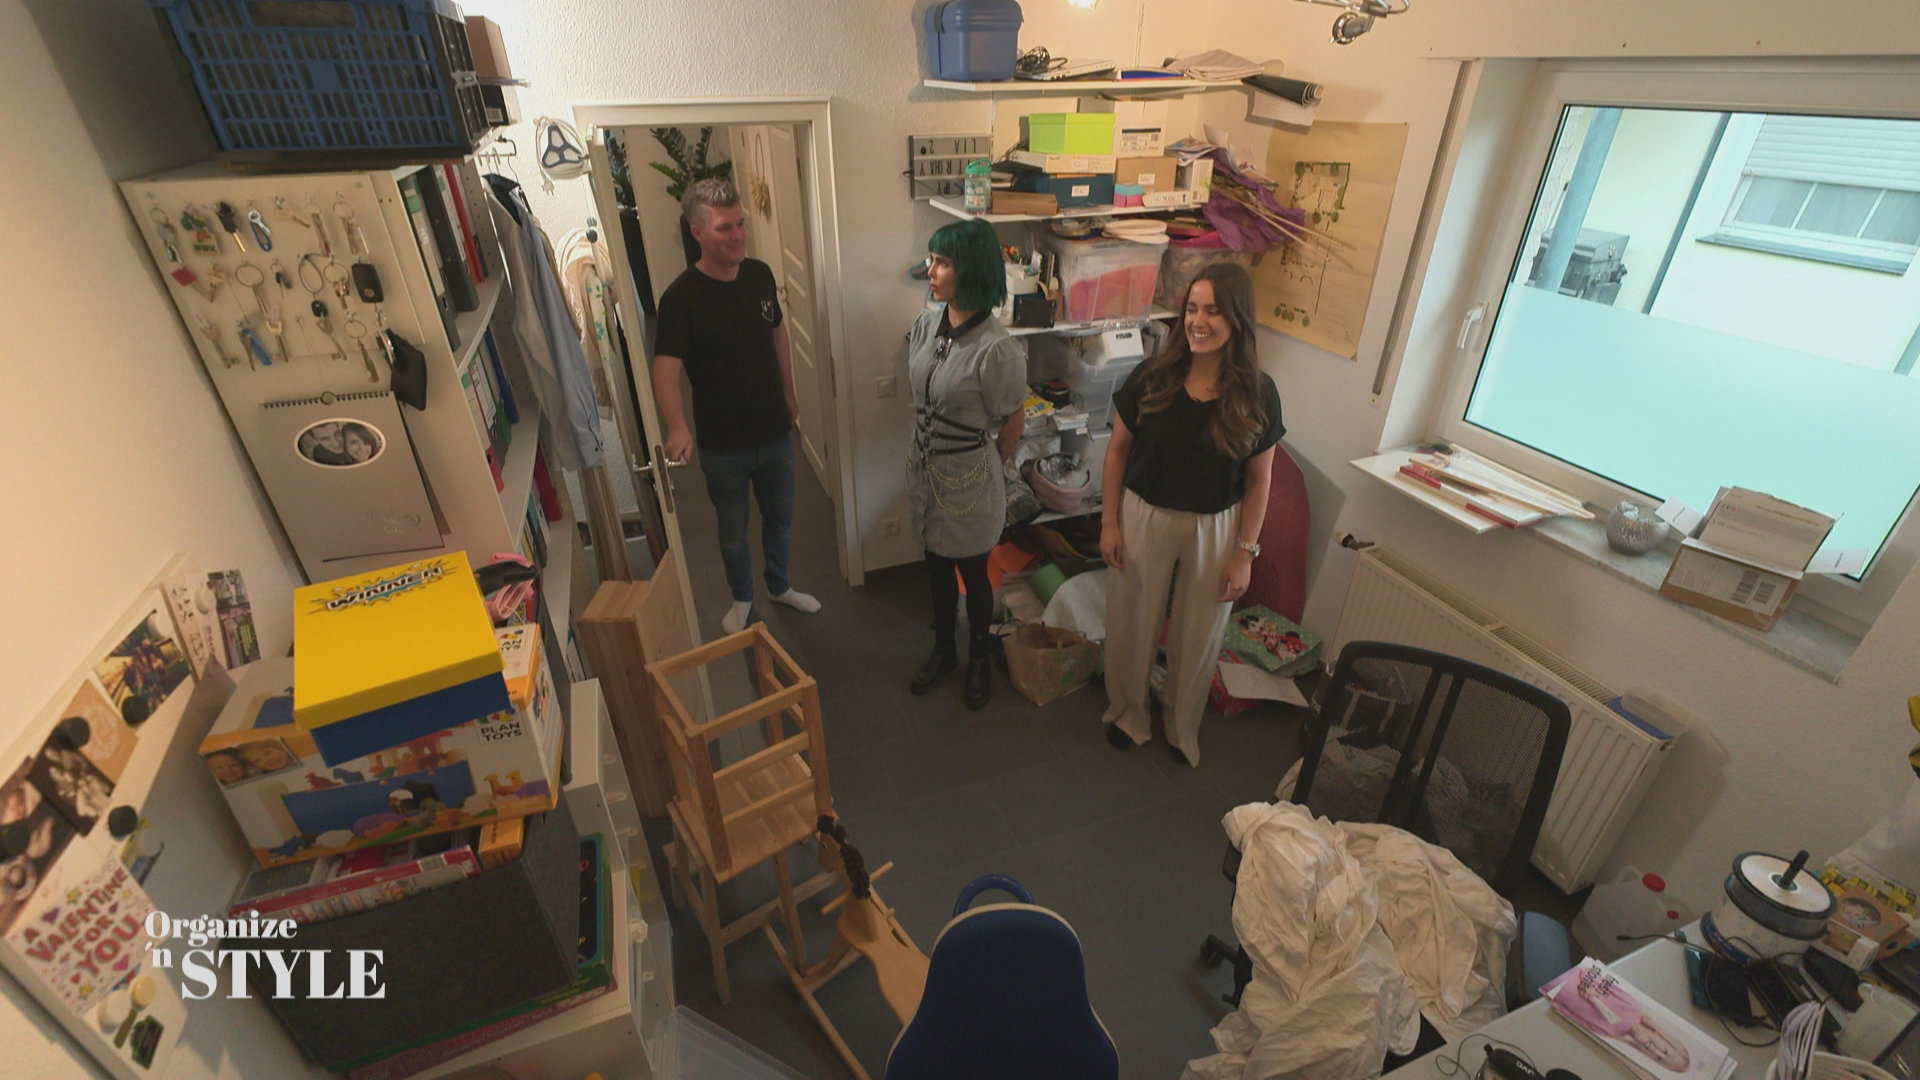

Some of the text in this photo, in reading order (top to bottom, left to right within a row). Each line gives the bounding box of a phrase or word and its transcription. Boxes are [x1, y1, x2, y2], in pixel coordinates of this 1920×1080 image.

[327, 566, 442, 610] WINNER
[481, 721, 520, 735] PLAN
[483, 729, 522, 742] TOYS
[26, 867, 128, 962] VALENTINE
[24, 928, 40, 944] A
[73, 915, 114, 955] FOR
[76, 914, 141, 975] YOU
[1515, 1060, 1535, 1076] JVC
